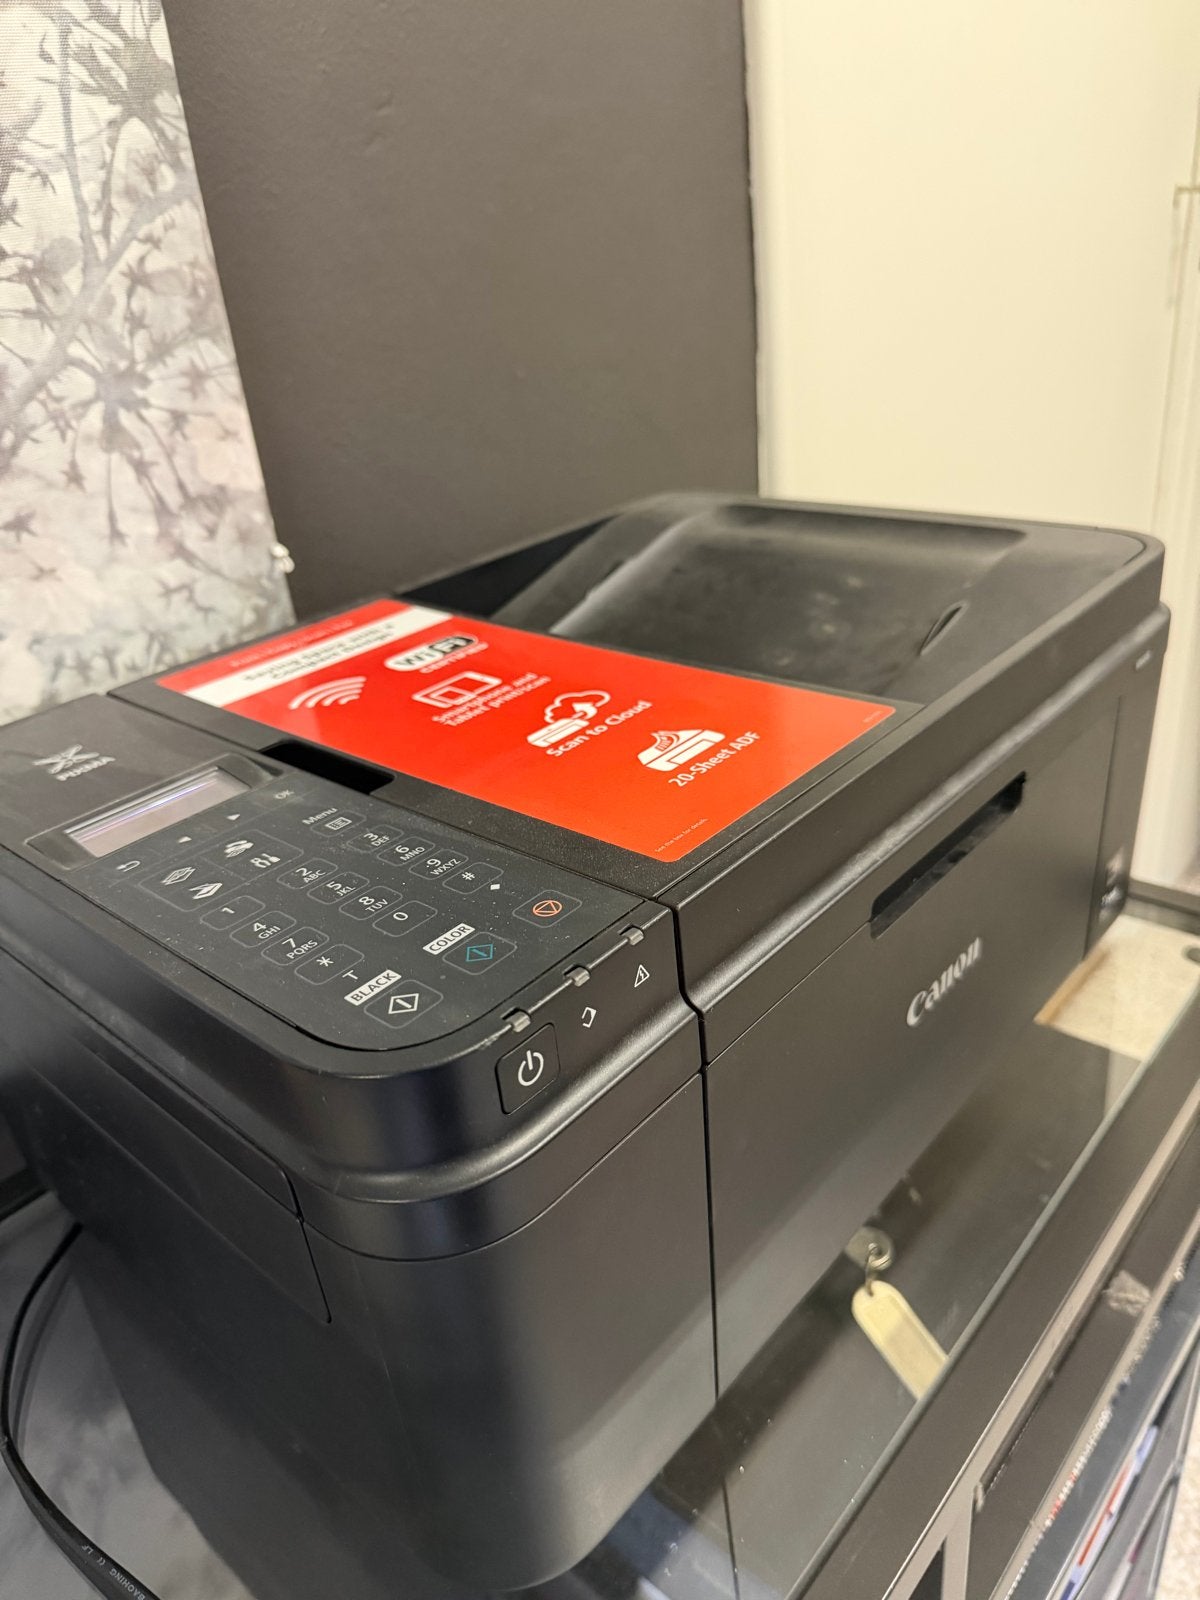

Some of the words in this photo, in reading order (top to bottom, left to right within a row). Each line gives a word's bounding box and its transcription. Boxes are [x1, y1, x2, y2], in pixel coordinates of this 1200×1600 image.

[546, 734, 589, 758] Scan
[589, 722, 608, 735] to
[605, 700, 653, 724] Cloud
[668, 747, 734, 788] 20-Sheet
[731, 731, 762, 754] ADF
[302, 807, 337, 825] Menu
[364, 832, 378, 841] 3
[373, 835, 390, 847] DEF
[395, 844, 409, 854] 6
[400, 846, 425, 861] MNO
[427, 858, 441, 867] 9
[430, 858, 461, 876] WXYZ
[295, 867, 312, 877] 2
[303, 869, 326, 884] ABC
[326, 881, 342, 891] 5
[336, 885, 356, 897] JKL
[358, 896, 375, 906] 8
[365, 899, 389, 913] TUV
[253, 922, 267, 932] 4
[258, 925, 281, 940] GHI
[281, 938, 296, 949] 7
[429, 925, 470, 952] COLOR
[286, 939, 318, 960] PQRS
[342, 970, 359, 980] T
[907, 937, 981, 1027] Canon
[350, 972, 397, 1002] BLACK
